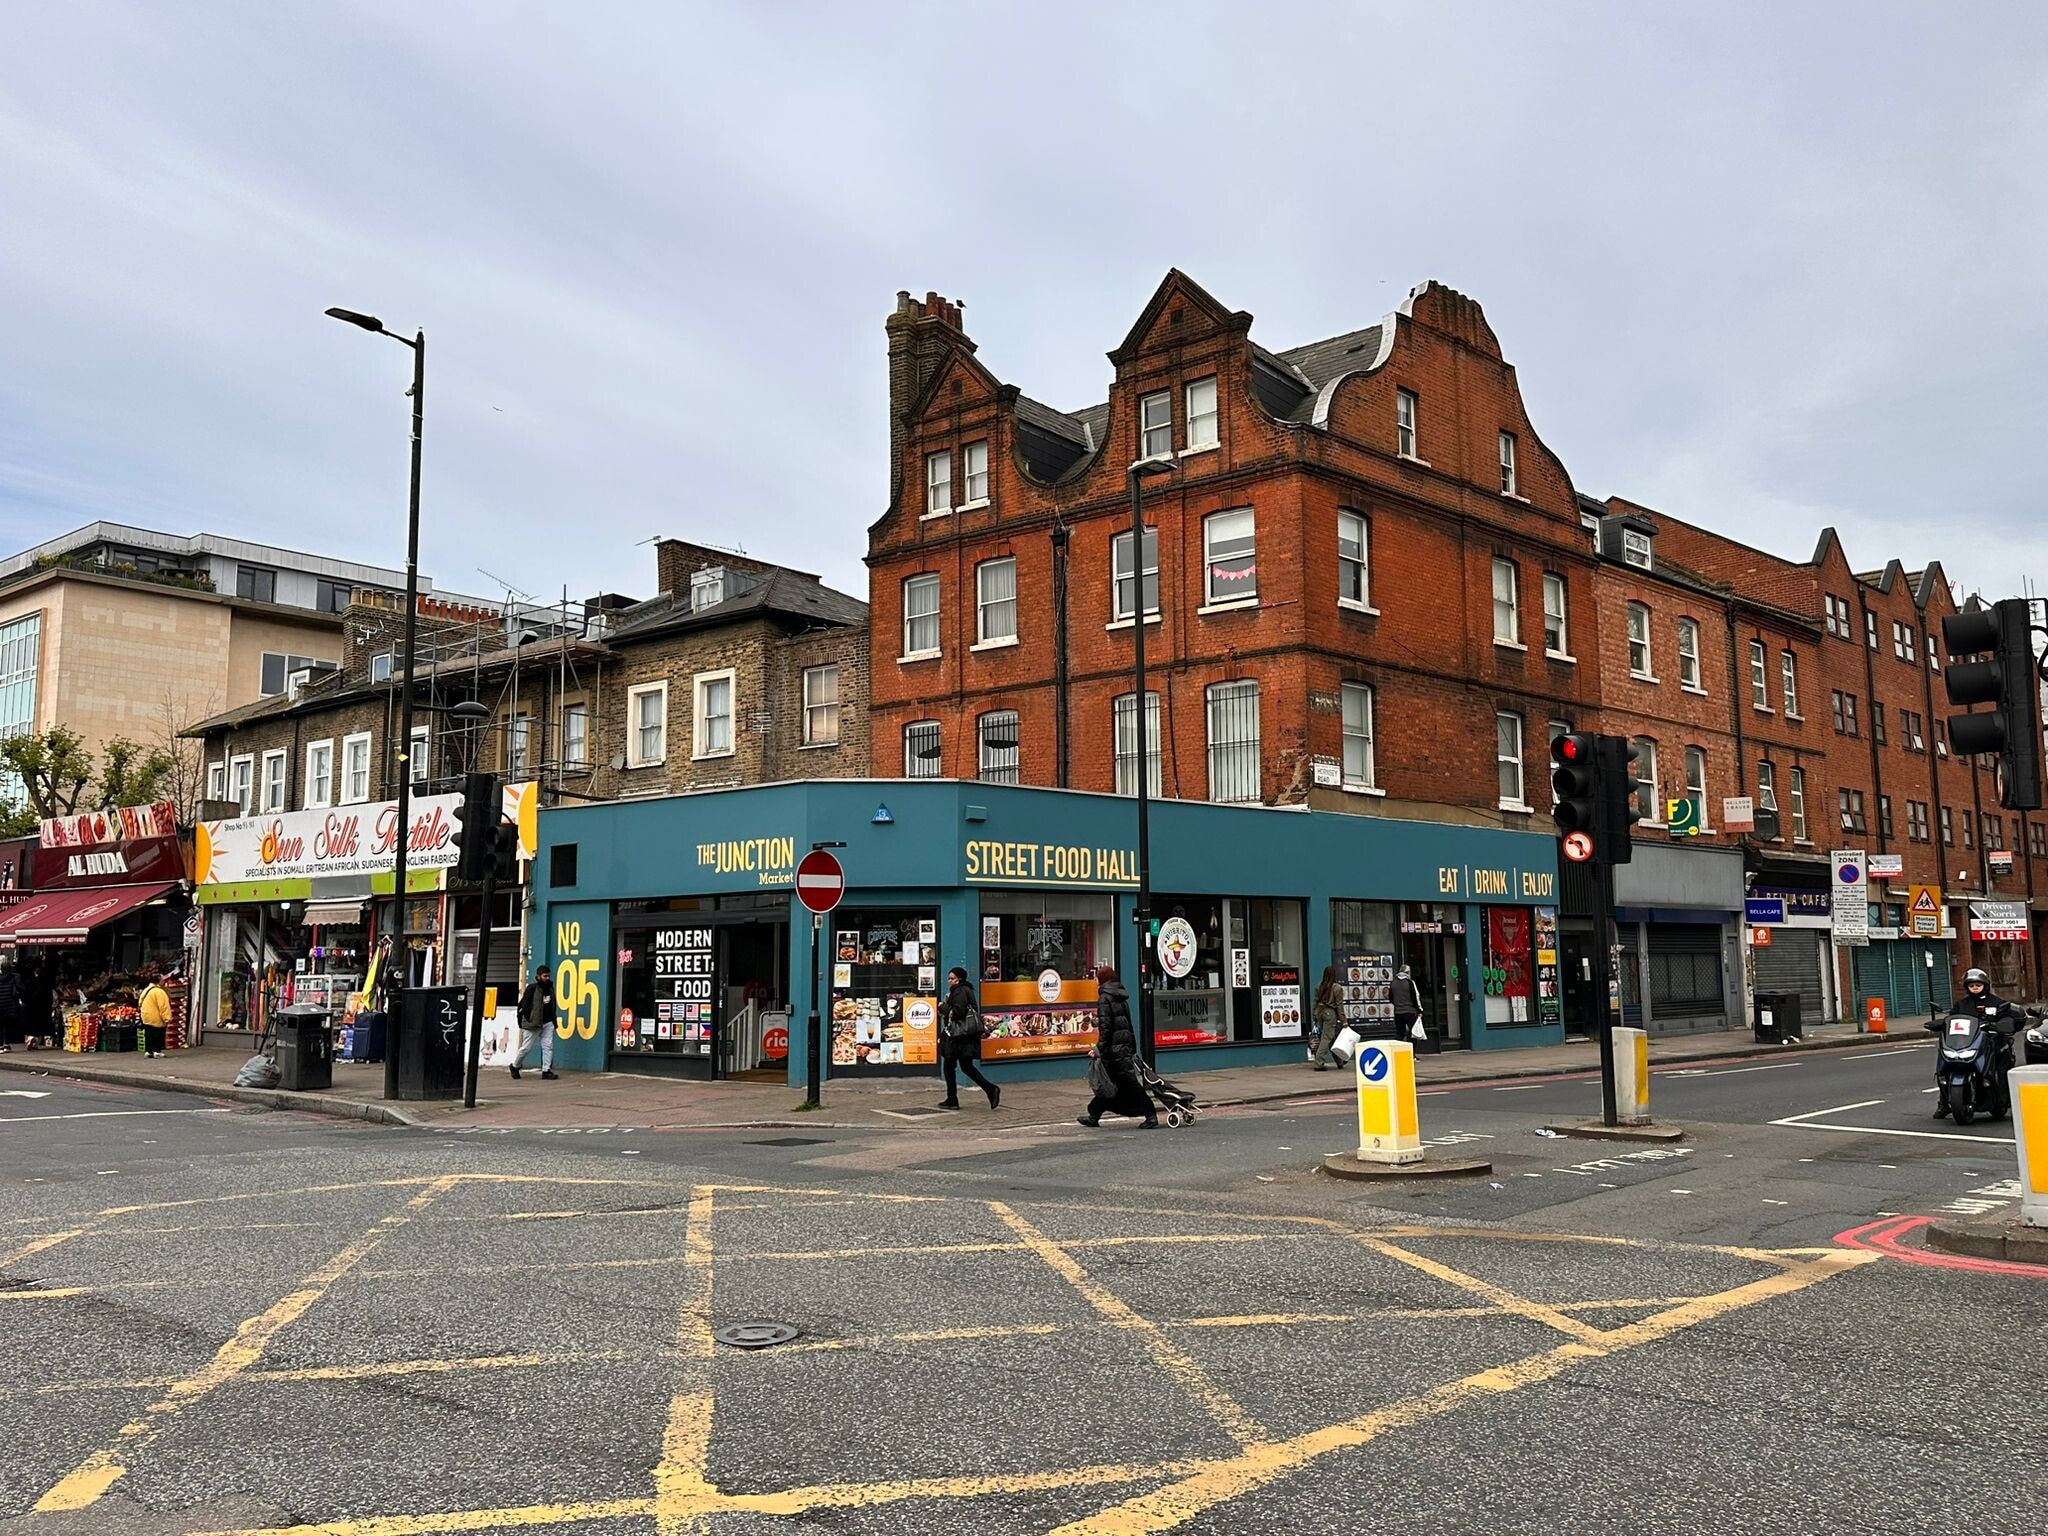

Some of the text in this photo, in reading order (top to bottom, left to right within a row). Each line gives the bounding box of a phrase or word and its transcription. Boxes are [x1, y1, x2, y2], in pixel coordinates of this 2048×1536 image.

[1317, 775, 1330, 783] ROAD
[224, 823, 235, 832] Shop
[261, 805, 451, 864] Sun Silk Tetile
[67, 851, 128, 877] AL HUDA
[696, 837, 794, 873] THE JUNCTION
[966, 841, 1141, 881] STREET FOOD HALL
[245, 866, 276, 878] SPECIALISTS
[277, 866, 283, 875] IN
[306, 863, 333, 873] ERITREAN
[361, 859, 393, 869] SUDANESE
[406, 855, 430, 866] NGLISH
[430, 853, 459, 864] FABRICS
[758, 872, 794, 885] Market
[1440, 868, 1553, 897] EAT DRINK ENJOY
[1802, 893, 1826, 907] CAFE
[655, 929, 712, 949] MODERN
[1165, 927, 1190, 941] BURRITO
[1979, 931, 2022, 940] TO LET
[655, 954, 712, 973] STREET
[674, 979, 711, 998] FOOD
[555, 958, 600, 1040] 95
[1159, 998, 1208, 1017] THE JUNCTION
[621, 1010, 632, 1022] ria
[1190, 1016, 1209, 1024] Market
[1954, 1022, 1964, 1031] L
[766, 1031, 788, 1047] ria
